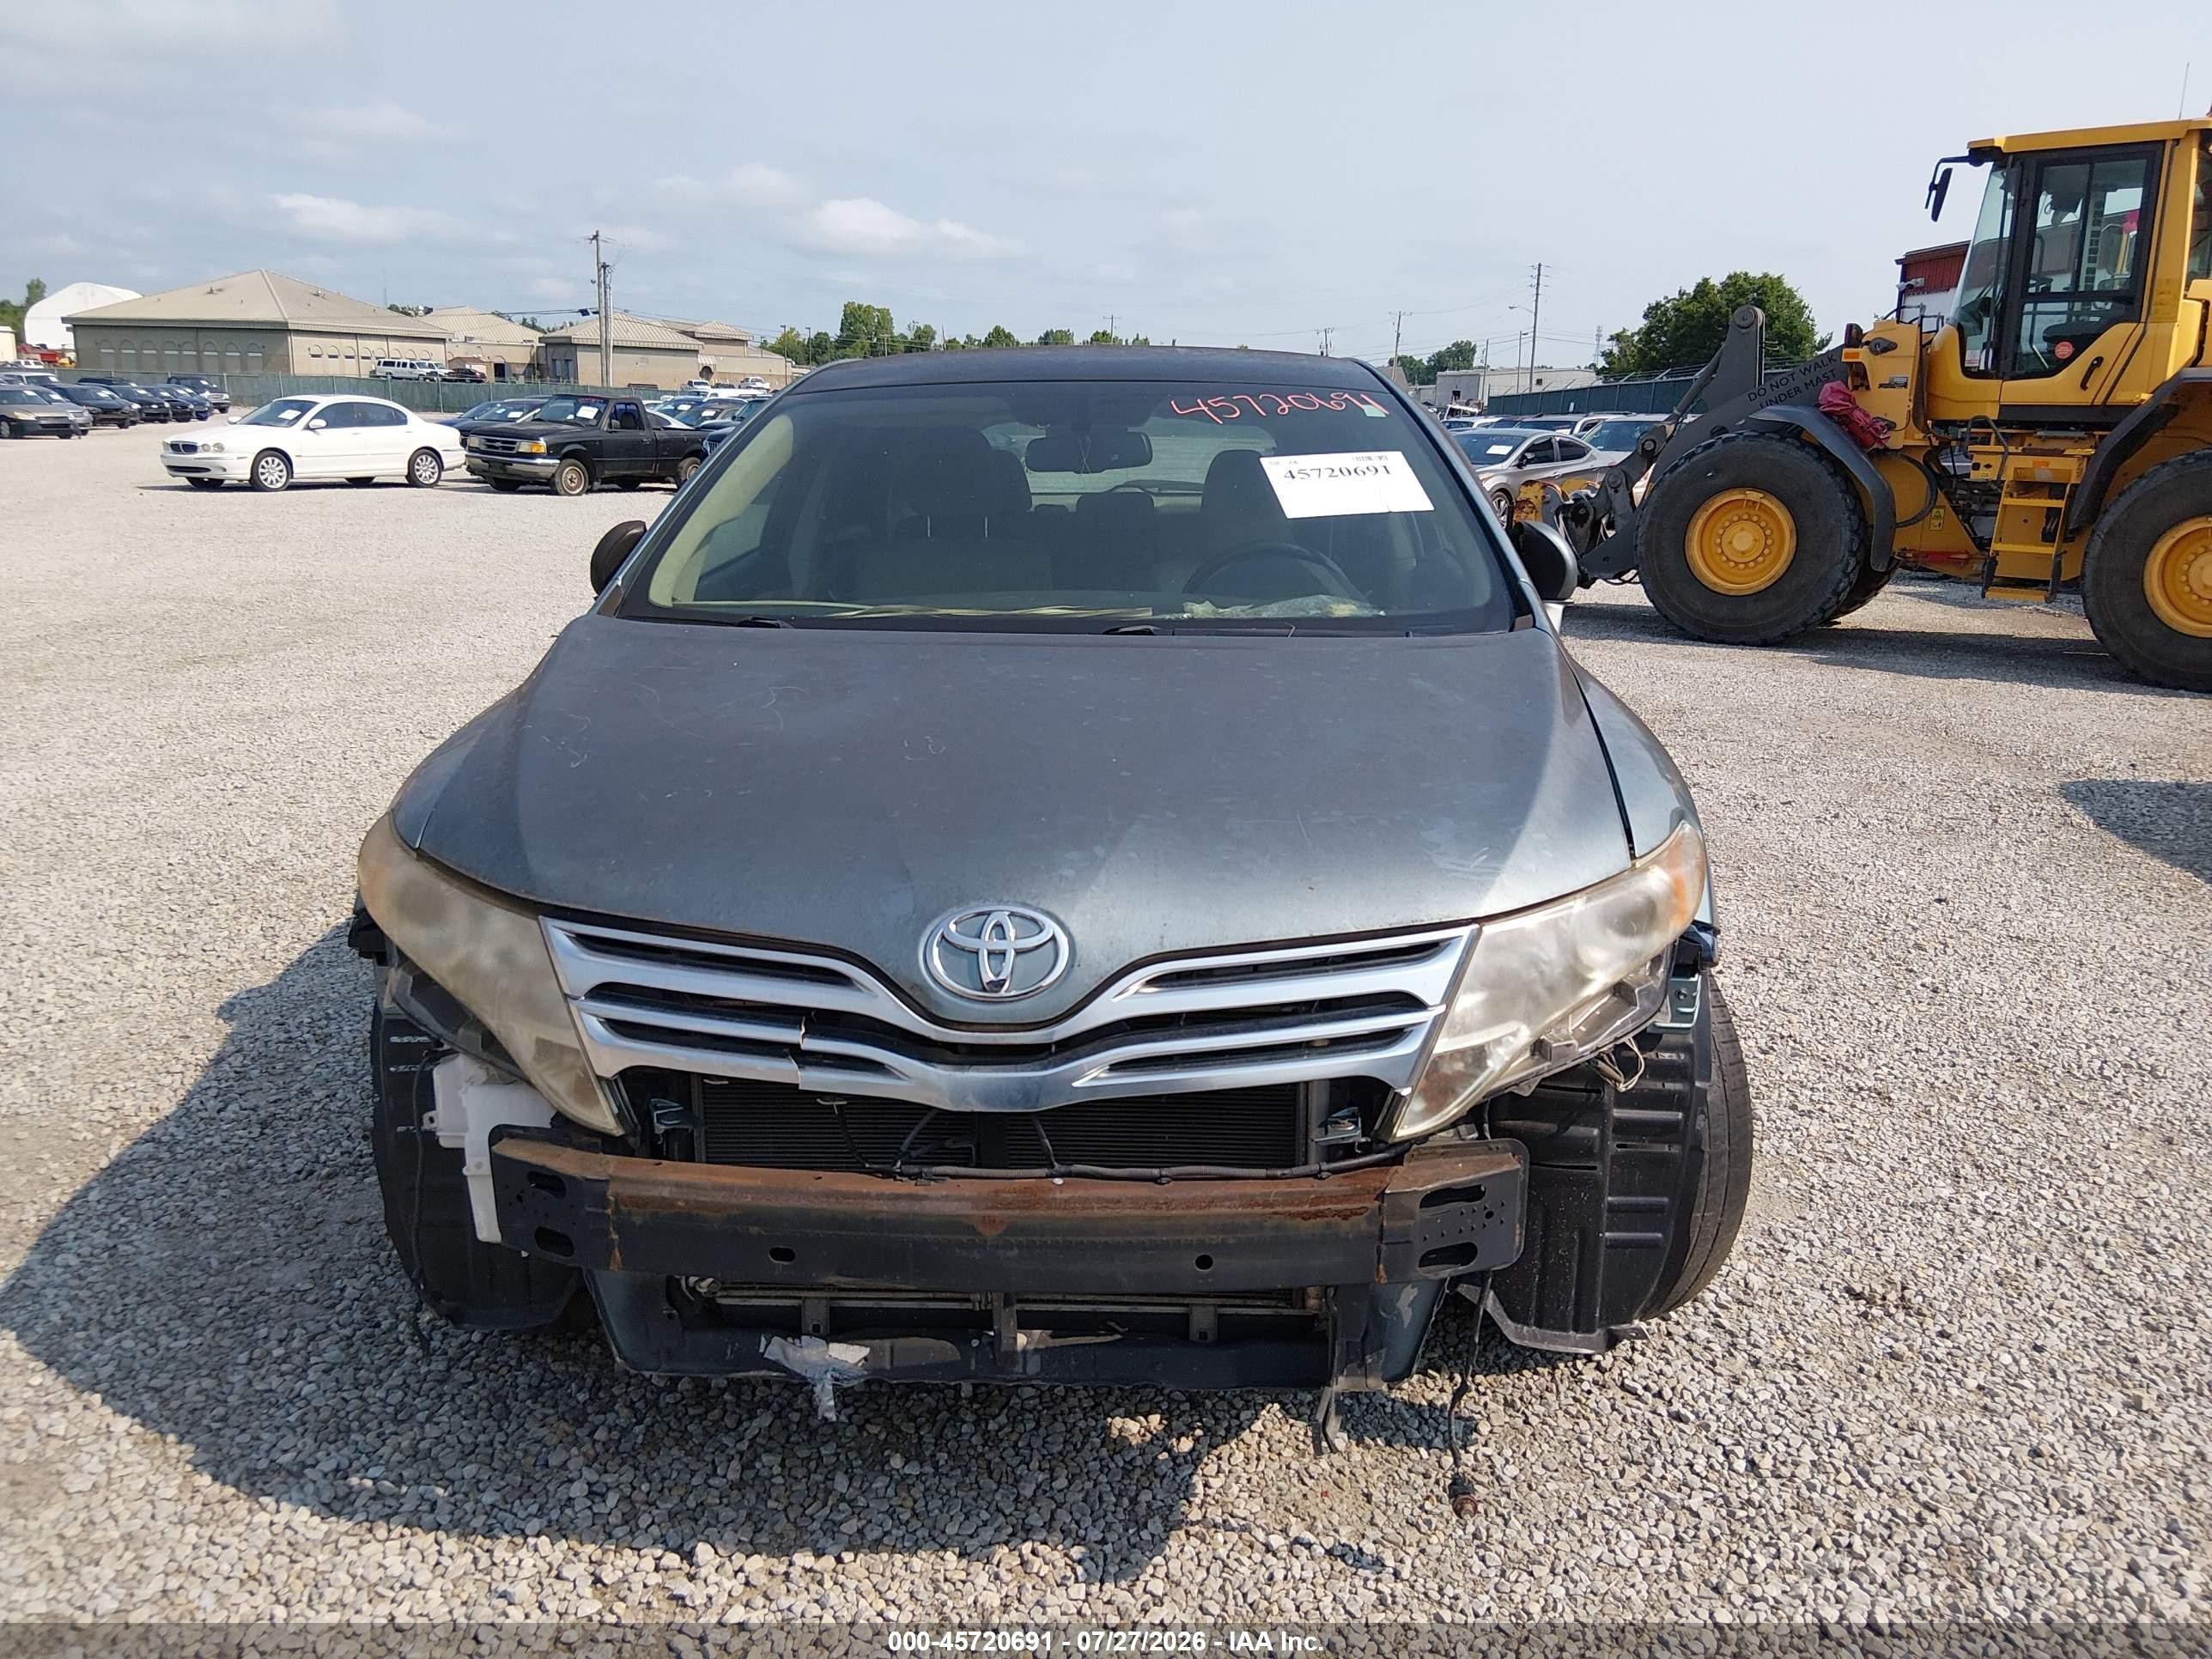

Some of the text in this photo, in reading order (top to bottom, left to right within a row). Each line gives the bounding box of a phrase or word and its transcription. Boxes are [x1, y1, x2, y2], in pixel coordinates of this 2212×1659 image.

[1747, 353, 1838, 403] DO NOT WALK
[1759, 368, 1838, 410] UNDER MAST
[1170, 392, 1389, 425] 45720691
[1284, 464, 1392, 481] 45720691
